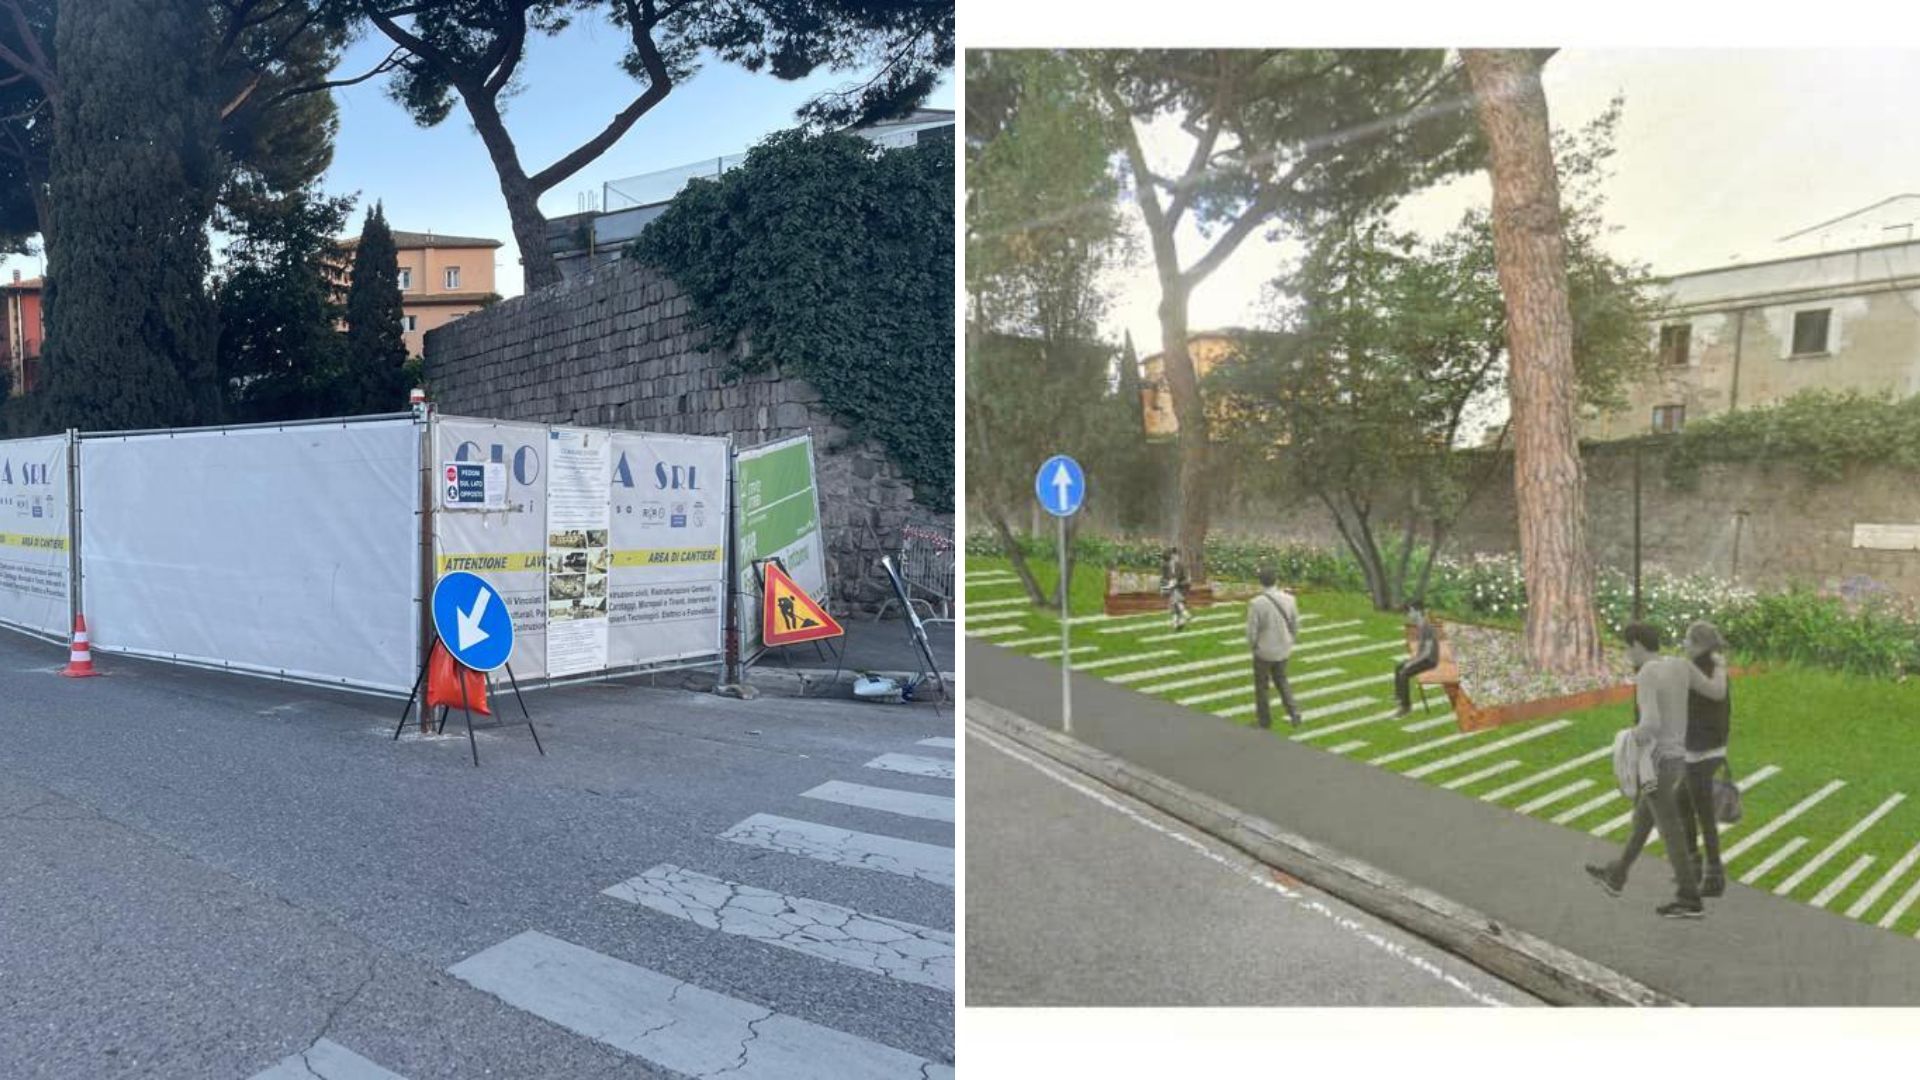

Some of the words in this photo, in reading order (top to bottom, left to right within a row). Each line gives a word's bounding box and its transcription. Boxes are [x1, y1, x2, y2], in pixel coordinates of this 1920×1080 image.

[22, 462, 51, 486] SRL
[611, 451, 634, 488] A
[655, 461, 701, 490] SRL
[40, 538, 65, 549] CANTIERE
[445, 556, 508, 570] ATTENZIONE
[647, 552, 669, 563] AREA
[670, 551, 680, 562] DI
[680, 549, 717, 561] CANTIERE
